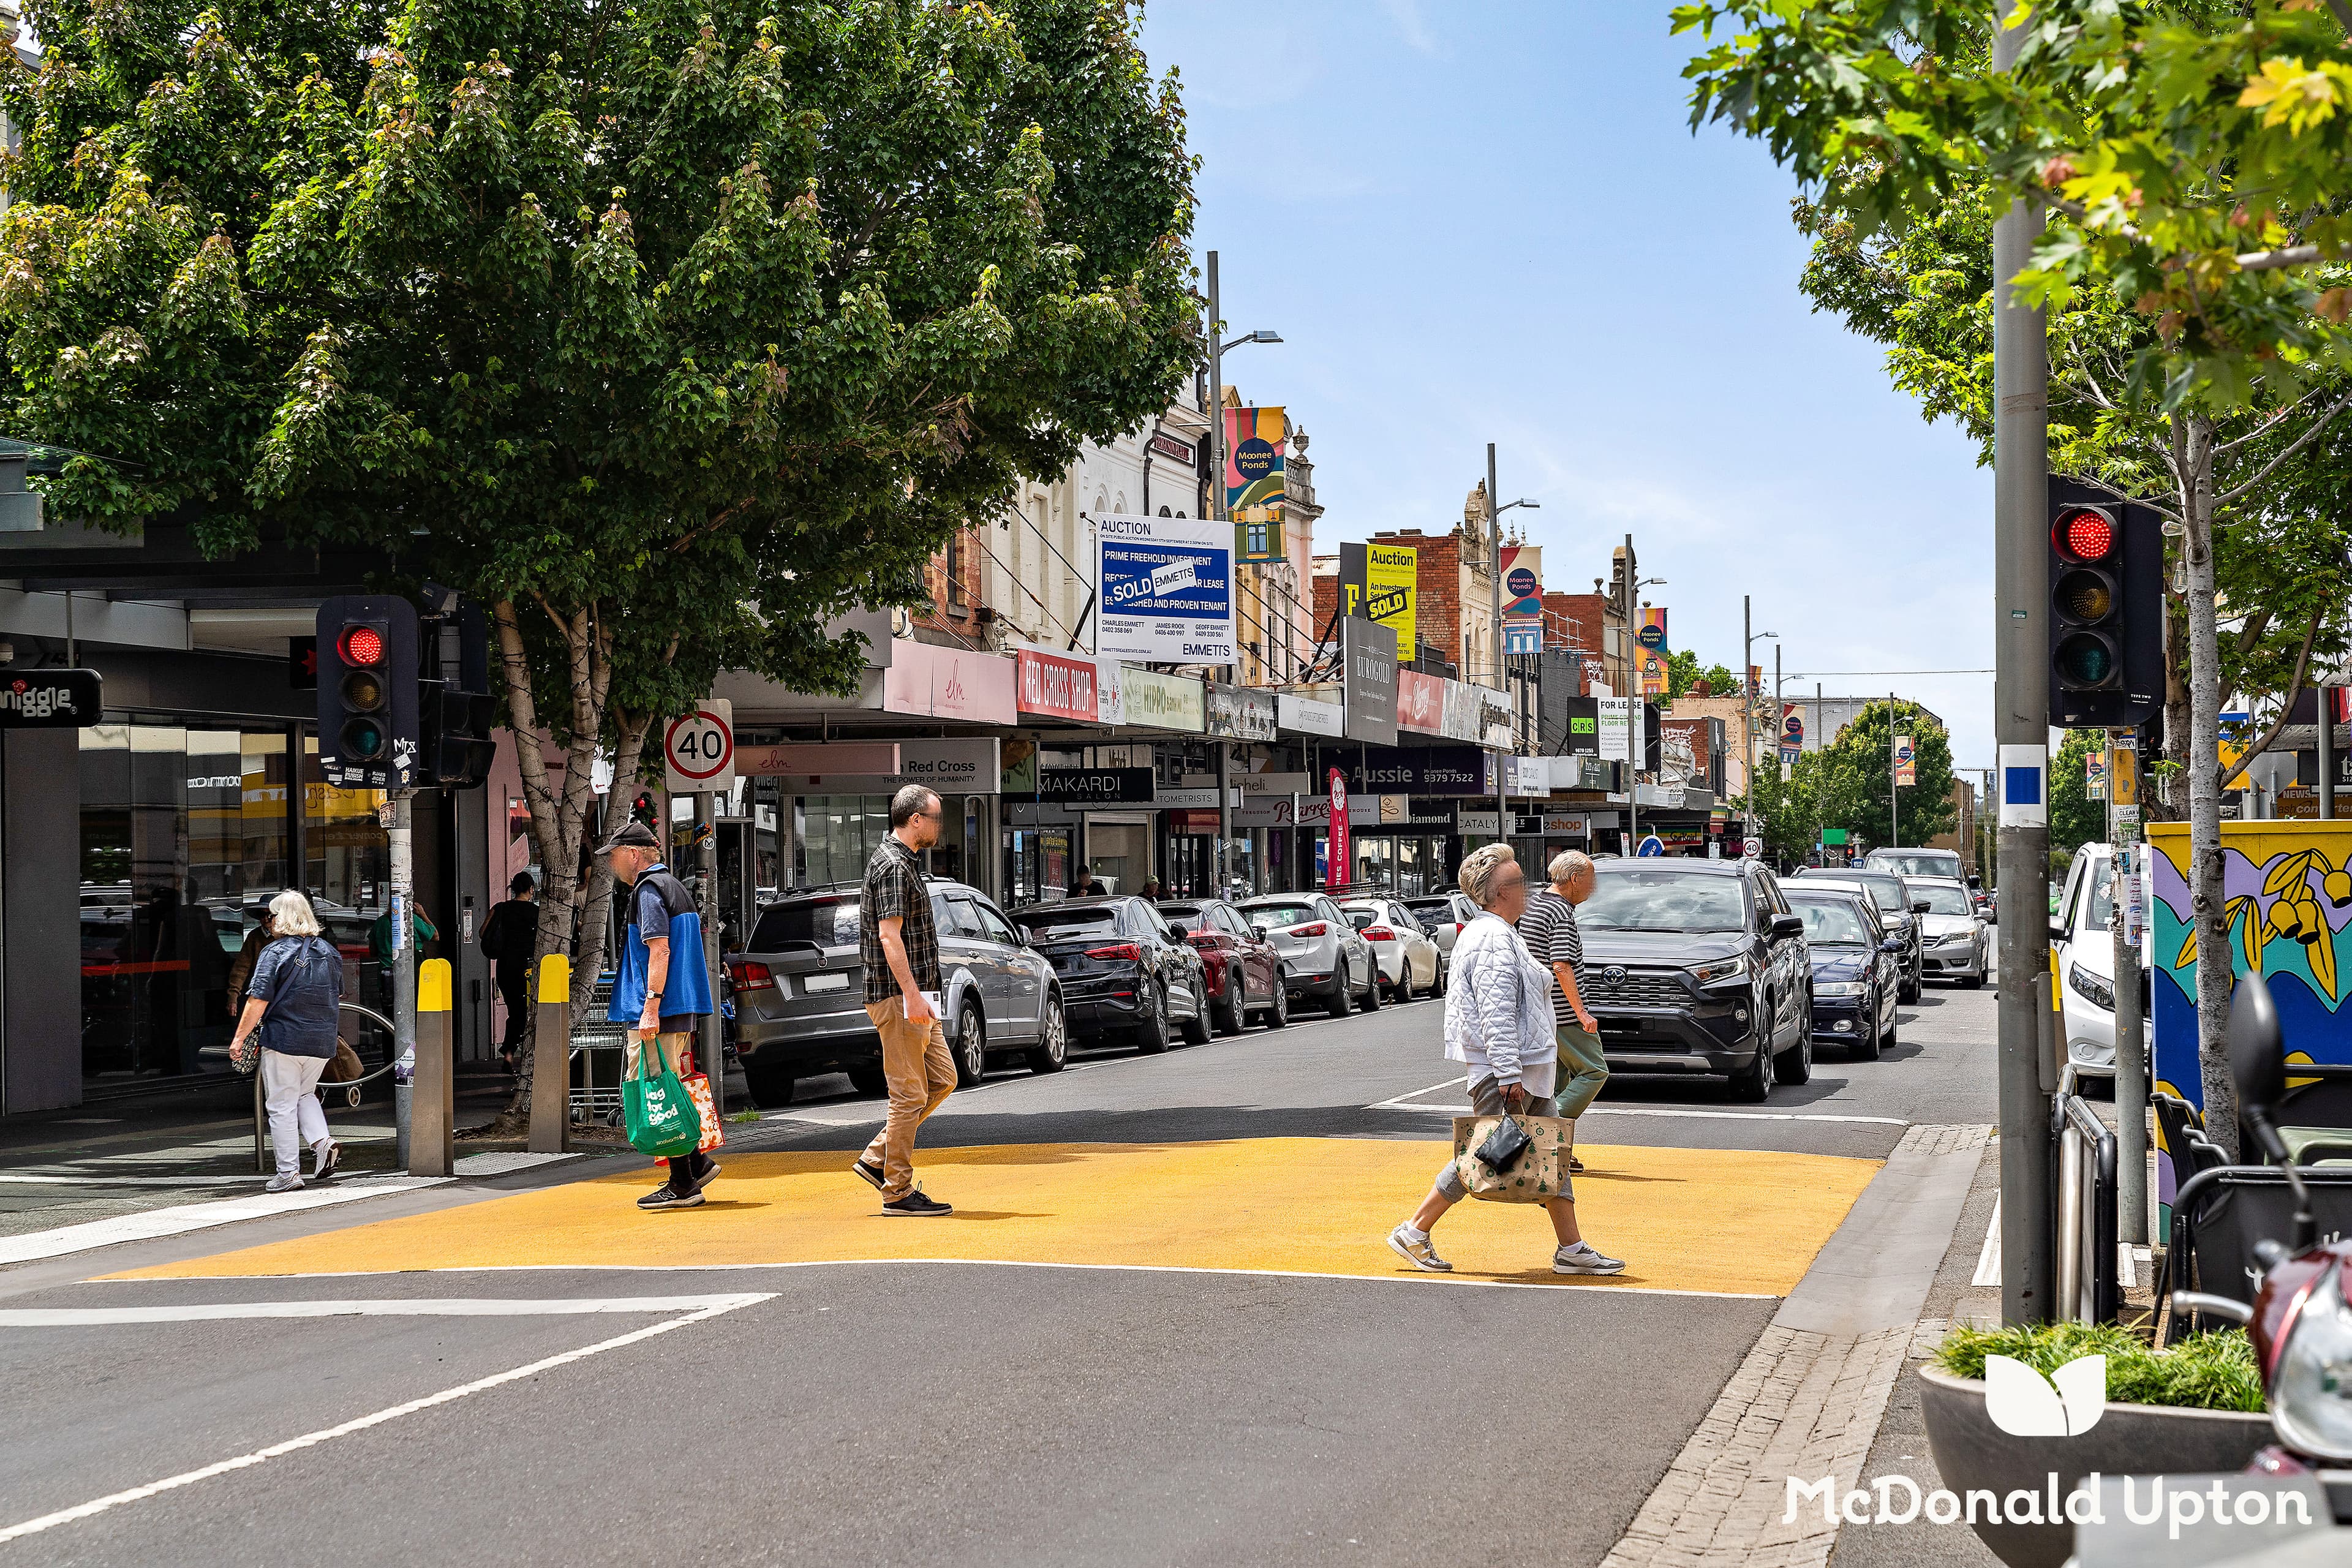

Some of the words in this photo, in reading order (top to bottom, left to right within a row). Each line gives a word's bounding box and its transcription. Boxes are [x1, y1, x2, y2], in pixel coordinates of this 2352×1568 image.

[1101, 520, 1150, 535] AUCTION
[1105, 551, 1128, 561] PRIME
[1130, 552, 1166, 564] FREEHOLD
[1371, 550, 1413, 567] Auction
[1155, 568, 1194, 588] EMMETTS
[1204, 579, 1224, 589] LEASE
[1113, 578, 1152, 601] SOLD
[1379, 583, 1411, 592] Investment
[1154, 600, 1168, 608] AND
[1170, 600, 1199, 609] PROVEN
[1200, 601, 1227, 611] TENANT
[1369, 594, 1404, 619] SOLD
[1183, 644, 1230, 657] EMMETTS
[1357, 656, 1390, 684] EUROGOLD
[946, 659, 965, 701] elm
[1025, 660, 1041, 704] RED
[1044, 663, 1069, 710] CROSS
[1071, 668, 1091, 712] SHOP
[1144, 684, 1166, 715] HIPPO
[1572, 723, 1593, 731] CRS
[677, 730, 722, 760] 40
[758, 750, 791, 769] elm
[908, 761, 933, 772] Red
[938, 760, 975, 772] Cross
[1352, 766, 1412, 783] Aussie
[1408, 813, 1450, 824] Diamond
[1459, 820, 1509, 828] CATALYT
[646, 1102, 663, 1112] for
[648, 1104, 679, 1125] good
[656, 1136, 680, 1146] Woolworths
